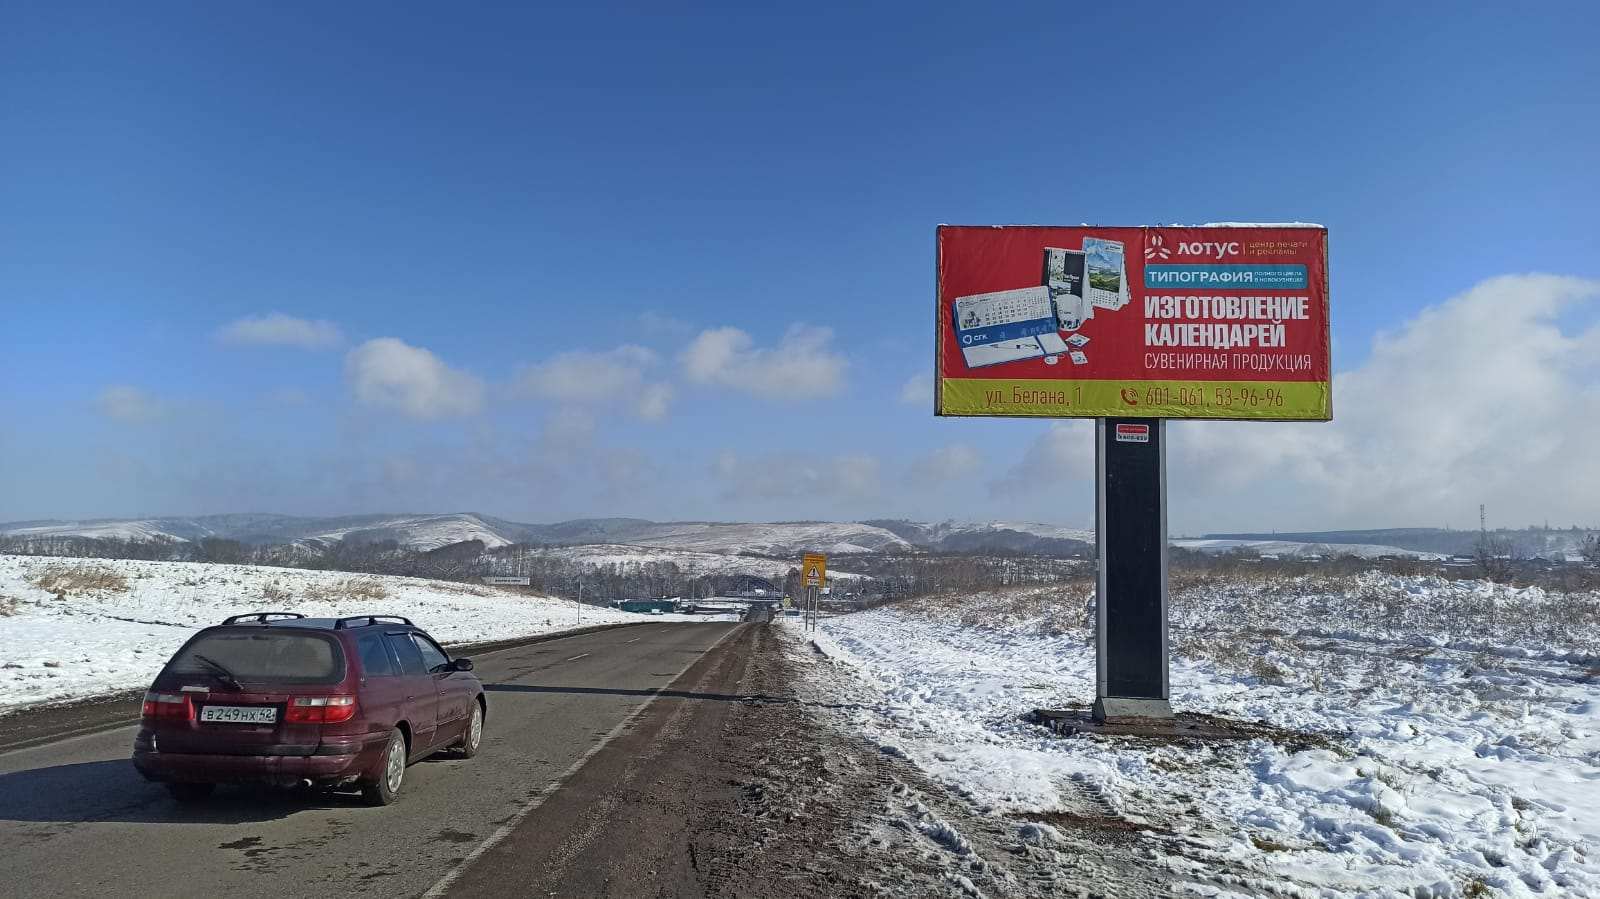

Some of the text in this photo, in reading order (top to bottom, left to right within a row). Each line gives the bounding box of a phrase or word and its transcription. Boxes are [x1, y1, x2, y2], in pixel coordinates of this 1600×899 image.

[1249, 241, 1308, 249] центр печати
[1257, 249, 1297, 257] рекламы
[1149, 271, 1253, 283] ТИПОГРАФИЯ
[1144, 295, 1309, 320] ИЗГОТОВЛЕНИЕ
[1144, 319, 1286, 349] КАЛЕНДАРЕЙ
[1144, 352, 1312, 372] СУВЕНИРНАЯ ПРОДУКЦИЯ
[985, 385, 1082, 408] ул. Белана, 1
[1145, 387, 1284, 407] 601-061, 53-96-96
